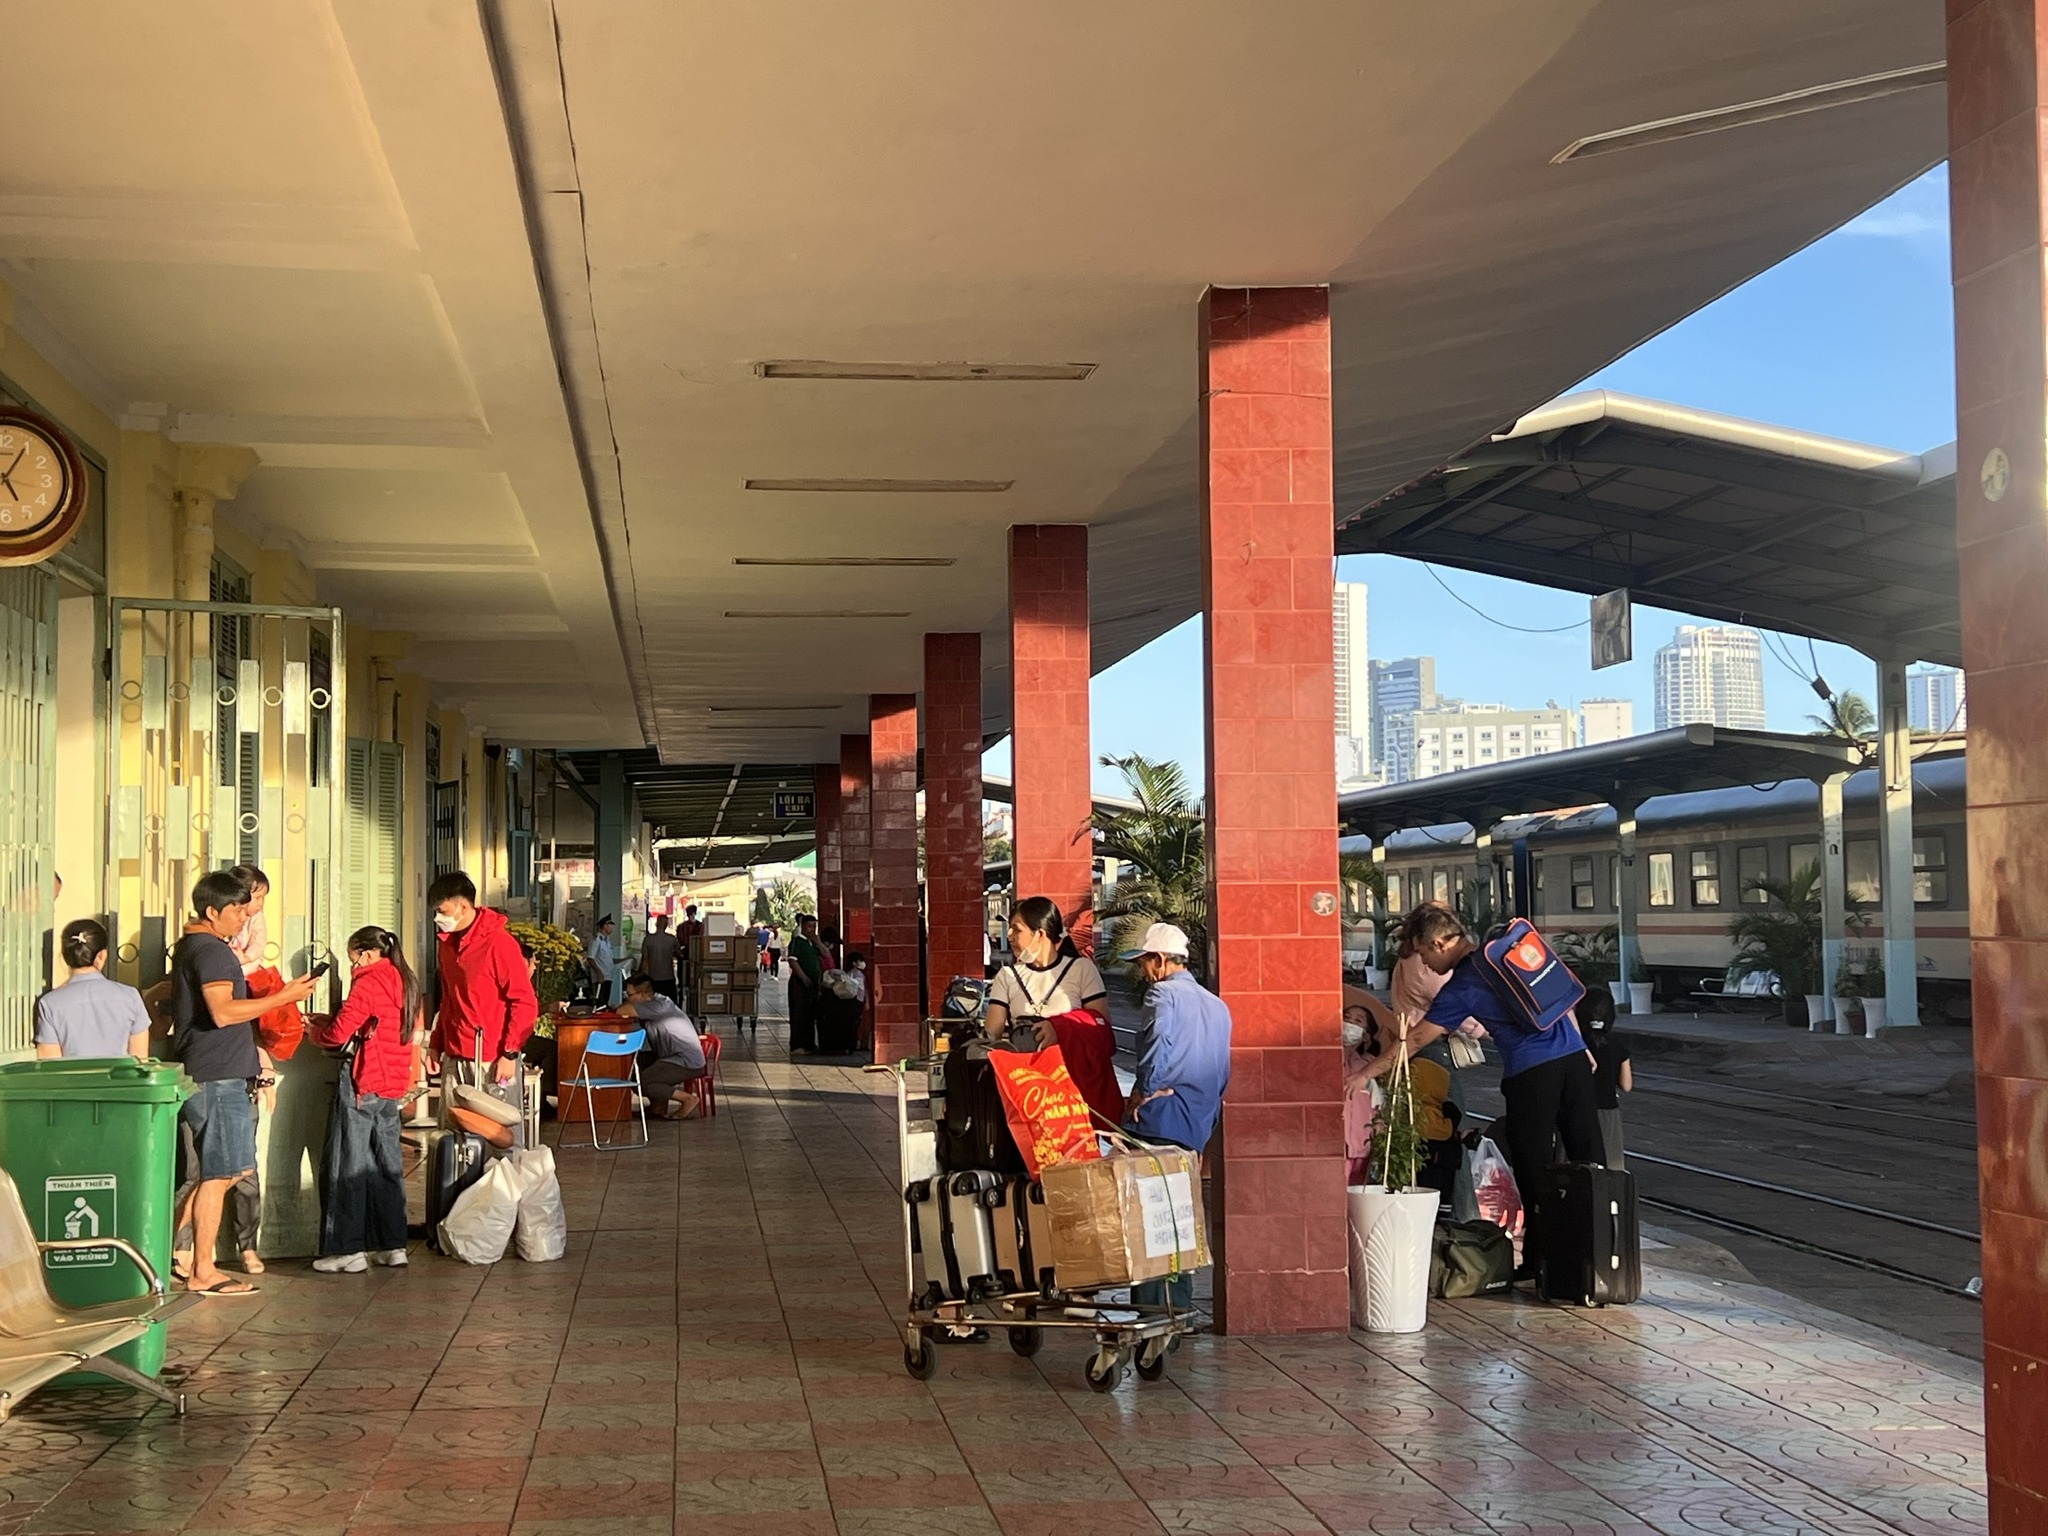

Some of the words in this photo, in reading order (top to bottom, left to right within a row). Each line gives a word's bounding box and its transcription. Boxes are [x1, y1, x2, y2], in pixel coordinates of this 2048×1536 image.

[23, 441, 30, 455] 1
[36, 456, 47, 469] 2
[41, 474, 52, 488] 3
[35, 492, 47, 507] 4
[0, 509, 12, 524] 6
[21, 505, 32, 520] 5
[785, 804, 804, 812] EXIT
